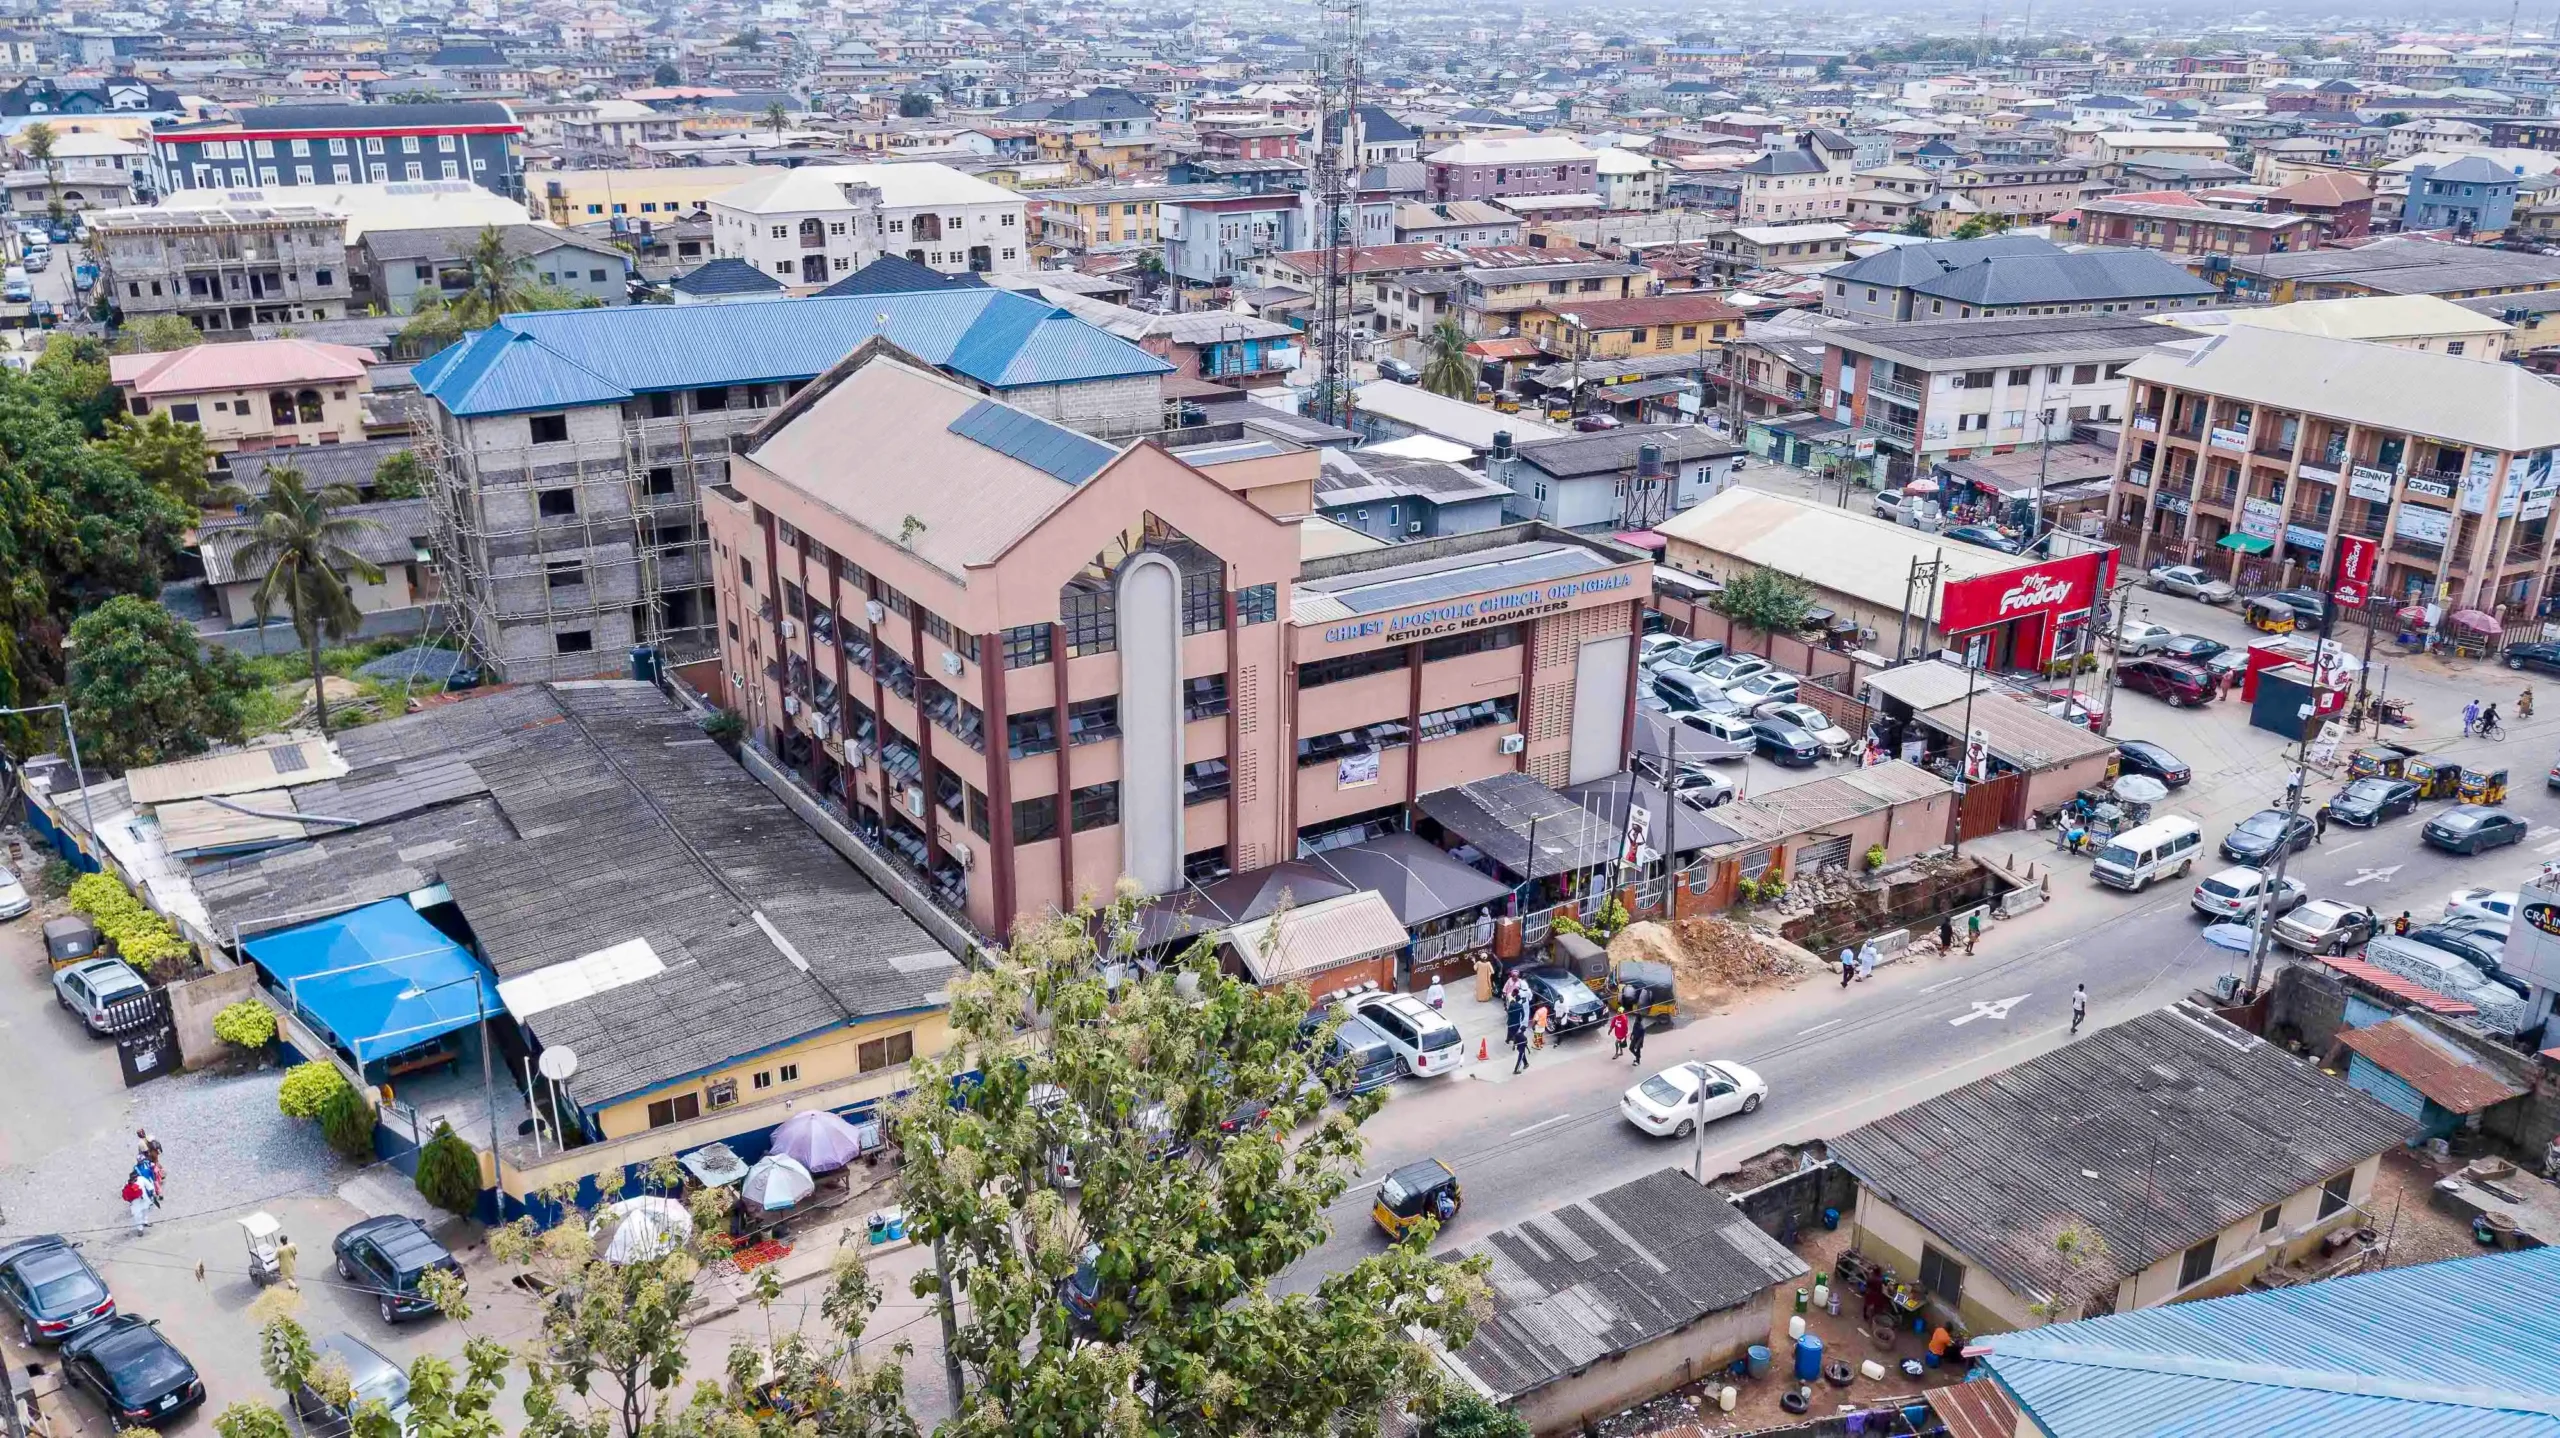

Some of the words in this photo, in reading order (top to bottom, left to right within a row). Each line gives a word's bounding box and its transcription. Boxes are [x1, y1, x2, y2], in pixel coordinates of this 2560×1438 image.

[2226, 437, 2245, 445] SOLAR
[2354, 468, 2390, 483] ZEINNY
[2408, 480, 2448, 496] CRAFTS
[1325, 619, 1384, 643] CHRIST
[1390, 602, 1475, 631] APOSTOLIC
[1386, 628, 1420, 643] KETU
[1461, 600, 1569, 629] HEADQUARTERS
[2525, 908, 2560, 928] CRAIN
